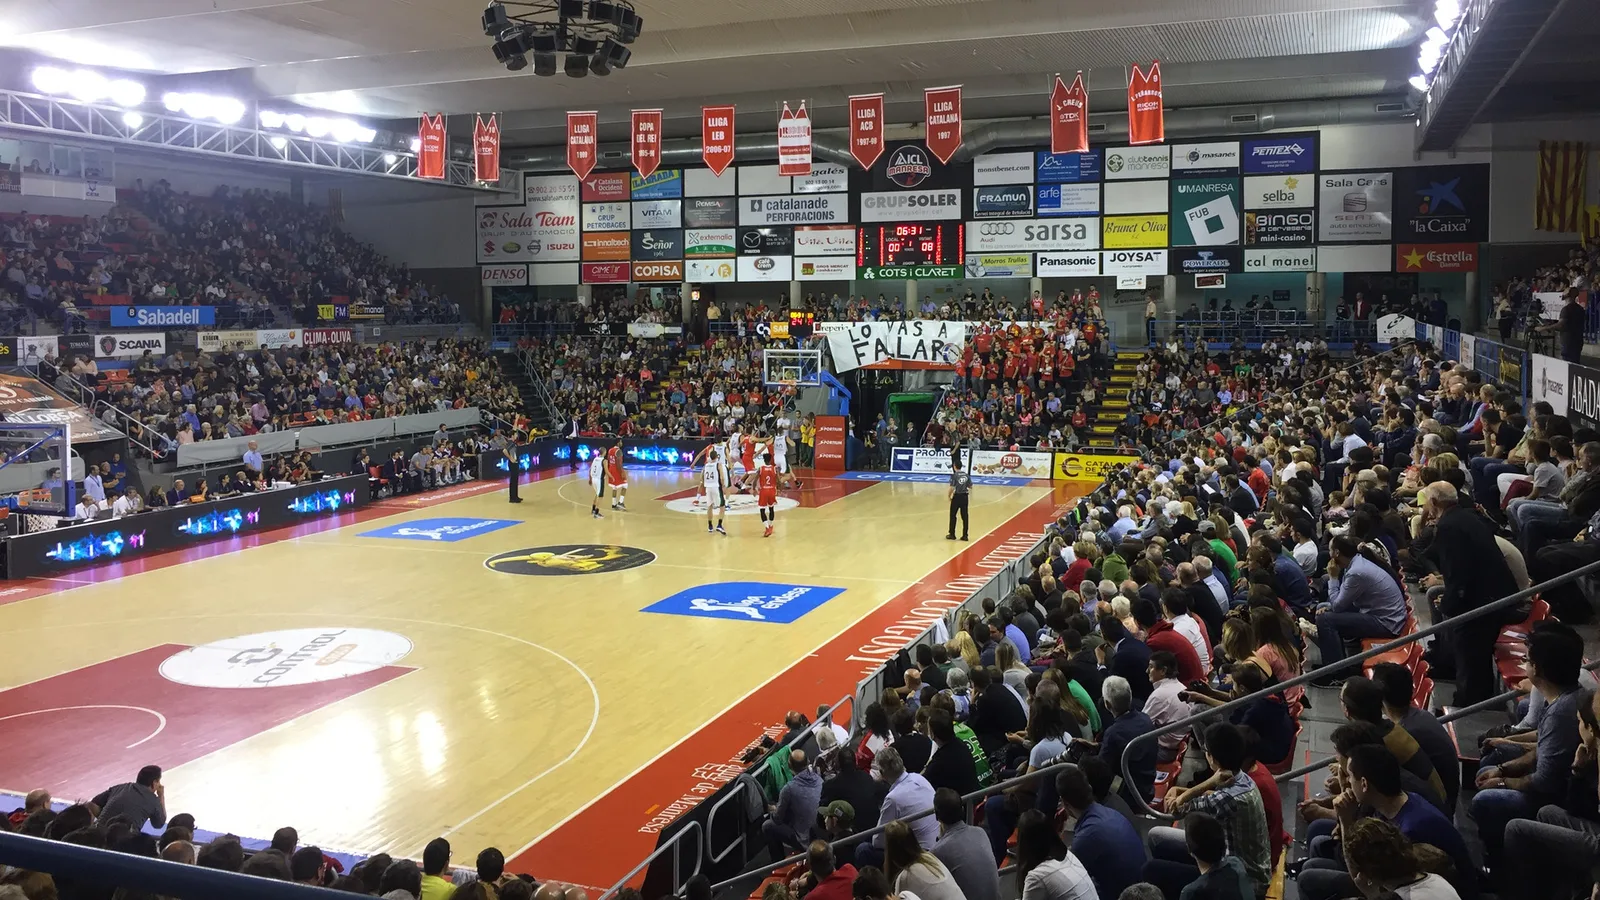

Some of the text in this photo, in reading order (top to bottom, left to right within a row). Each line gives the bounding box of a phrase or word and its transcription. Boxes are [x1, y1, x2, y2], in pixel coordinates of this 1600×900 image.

[934, 102, 953, 112] LLIGA
[857, 108, 876, 122] LLIGA
[708, 117, 728, 126] LLIGA
[712, 131, 725, 140] LEB
[937, 131, 951, 140] 1997
[1252, 146, 1292, 156] PENTEX
[888, 165, 930, 175] MANRESA
[1127, 162, 1168, 170] manresa
[1325, 179, 1353, 188] Sala
[1039, 186, 1060, 198] arfe
[1262, 190, 1295, 202] selba
[864, 194, 957, 208] GRUPSOLER
[979, 193, 1026, 203] FRAMUN
[765, 197, 829, 210] catalanade
[641, 209, 672, 217] VITAM
[766, 211, 835, 222] PERFORACIONS
[1189, 207, 1209, 221] FUB
[500, 211, 576, 229] Sala Team
[1256, 214, 1312, 226] BINGO
[587, 221, 627, 230] PETROBAGES
[1024, 223, 1087, 241] sarsa
[1260, 234, 1306, 242] mini-casino
[641, 238, 674, 250] Señor
[888, 243, 900, 252] 00
[921, 242, 933, 252] 08
[1040, 256, 1096, 266] Panasonic
[1109, 252, 1162, 262] JOYSAT
[1246, 254, 1313, 267] cal manel
[1426, 250, 1473, 262] Estrella
[482, 269, 526, 280] DENSO
[634, 265, 680, 277] COPISA
[879, 269, 907, 277] COTS
[915, 267, 956, 277] CLARET
[137, 308, 199, 325] Sabadell
[791, 318, 803, 326] 24
[849, 320, 947, 342] LO VAS A
[119, 340, 161, 350] SCANIA
[1003, 456, 1020, 465] FRIT
[706, 471, 714, 483] 24
[766, 476, 771, 484] 2
[253, 629, 348, 683] CONTROL
[637, 782, 721, 835] de Manresa
